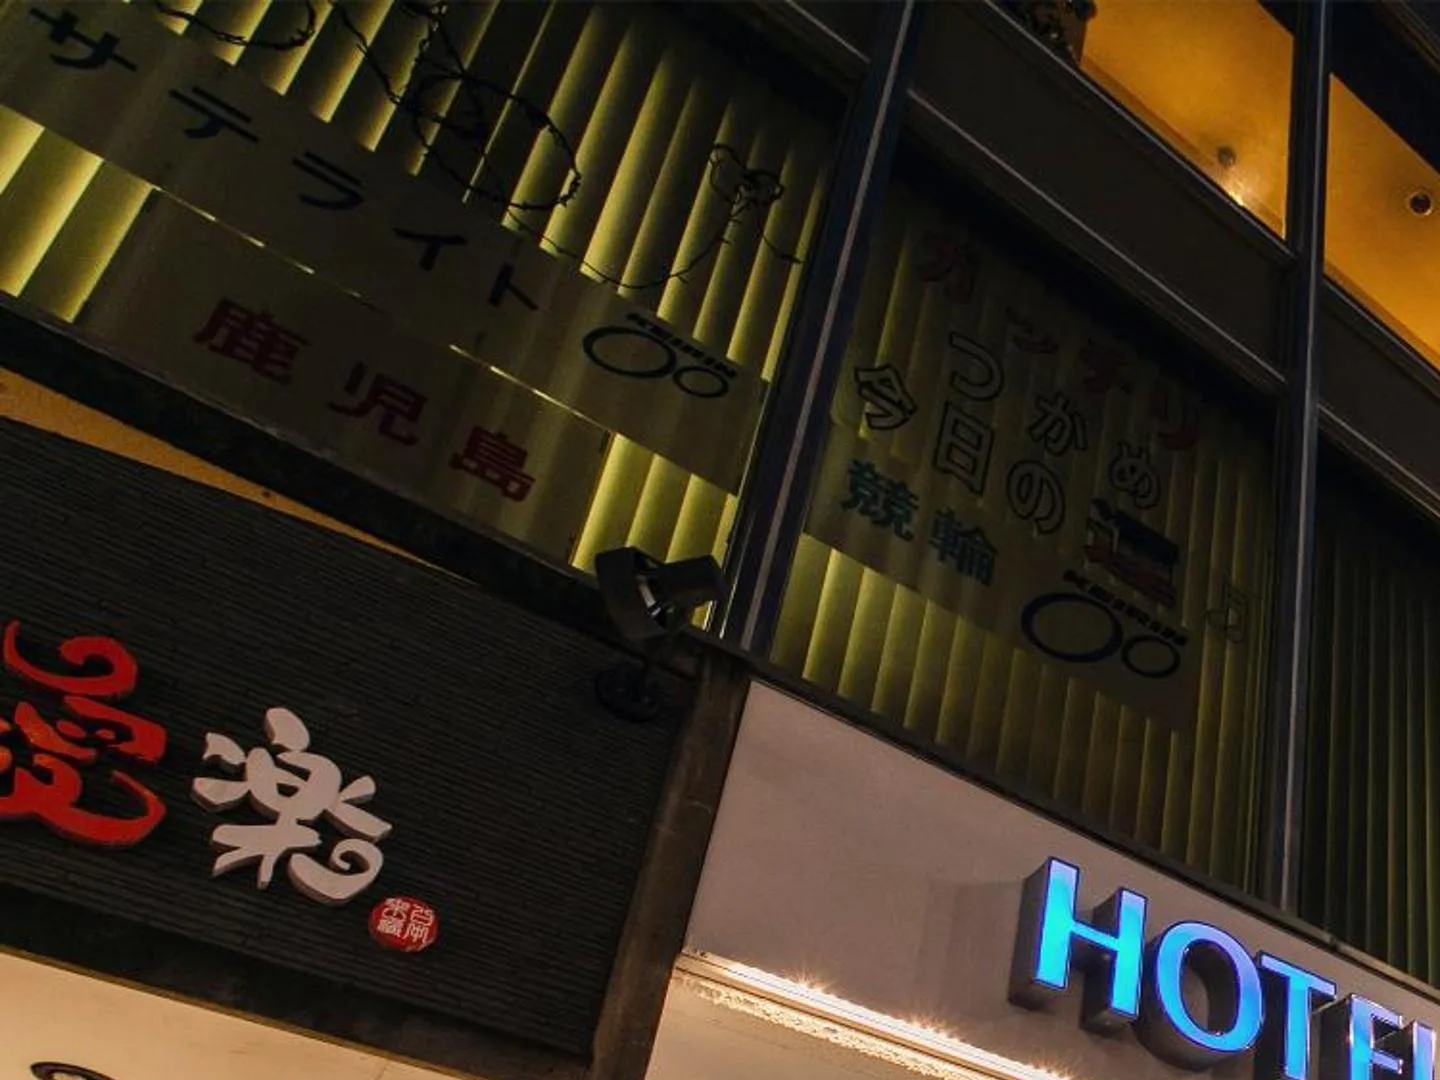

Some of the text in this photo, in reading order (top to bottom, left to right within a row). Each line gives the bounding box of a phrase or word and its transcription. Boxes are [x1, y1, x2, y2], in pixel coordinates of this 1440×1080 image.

[29, 6, 538, 312] サテライト
[192, 296, 538, 503] 鹿児島
